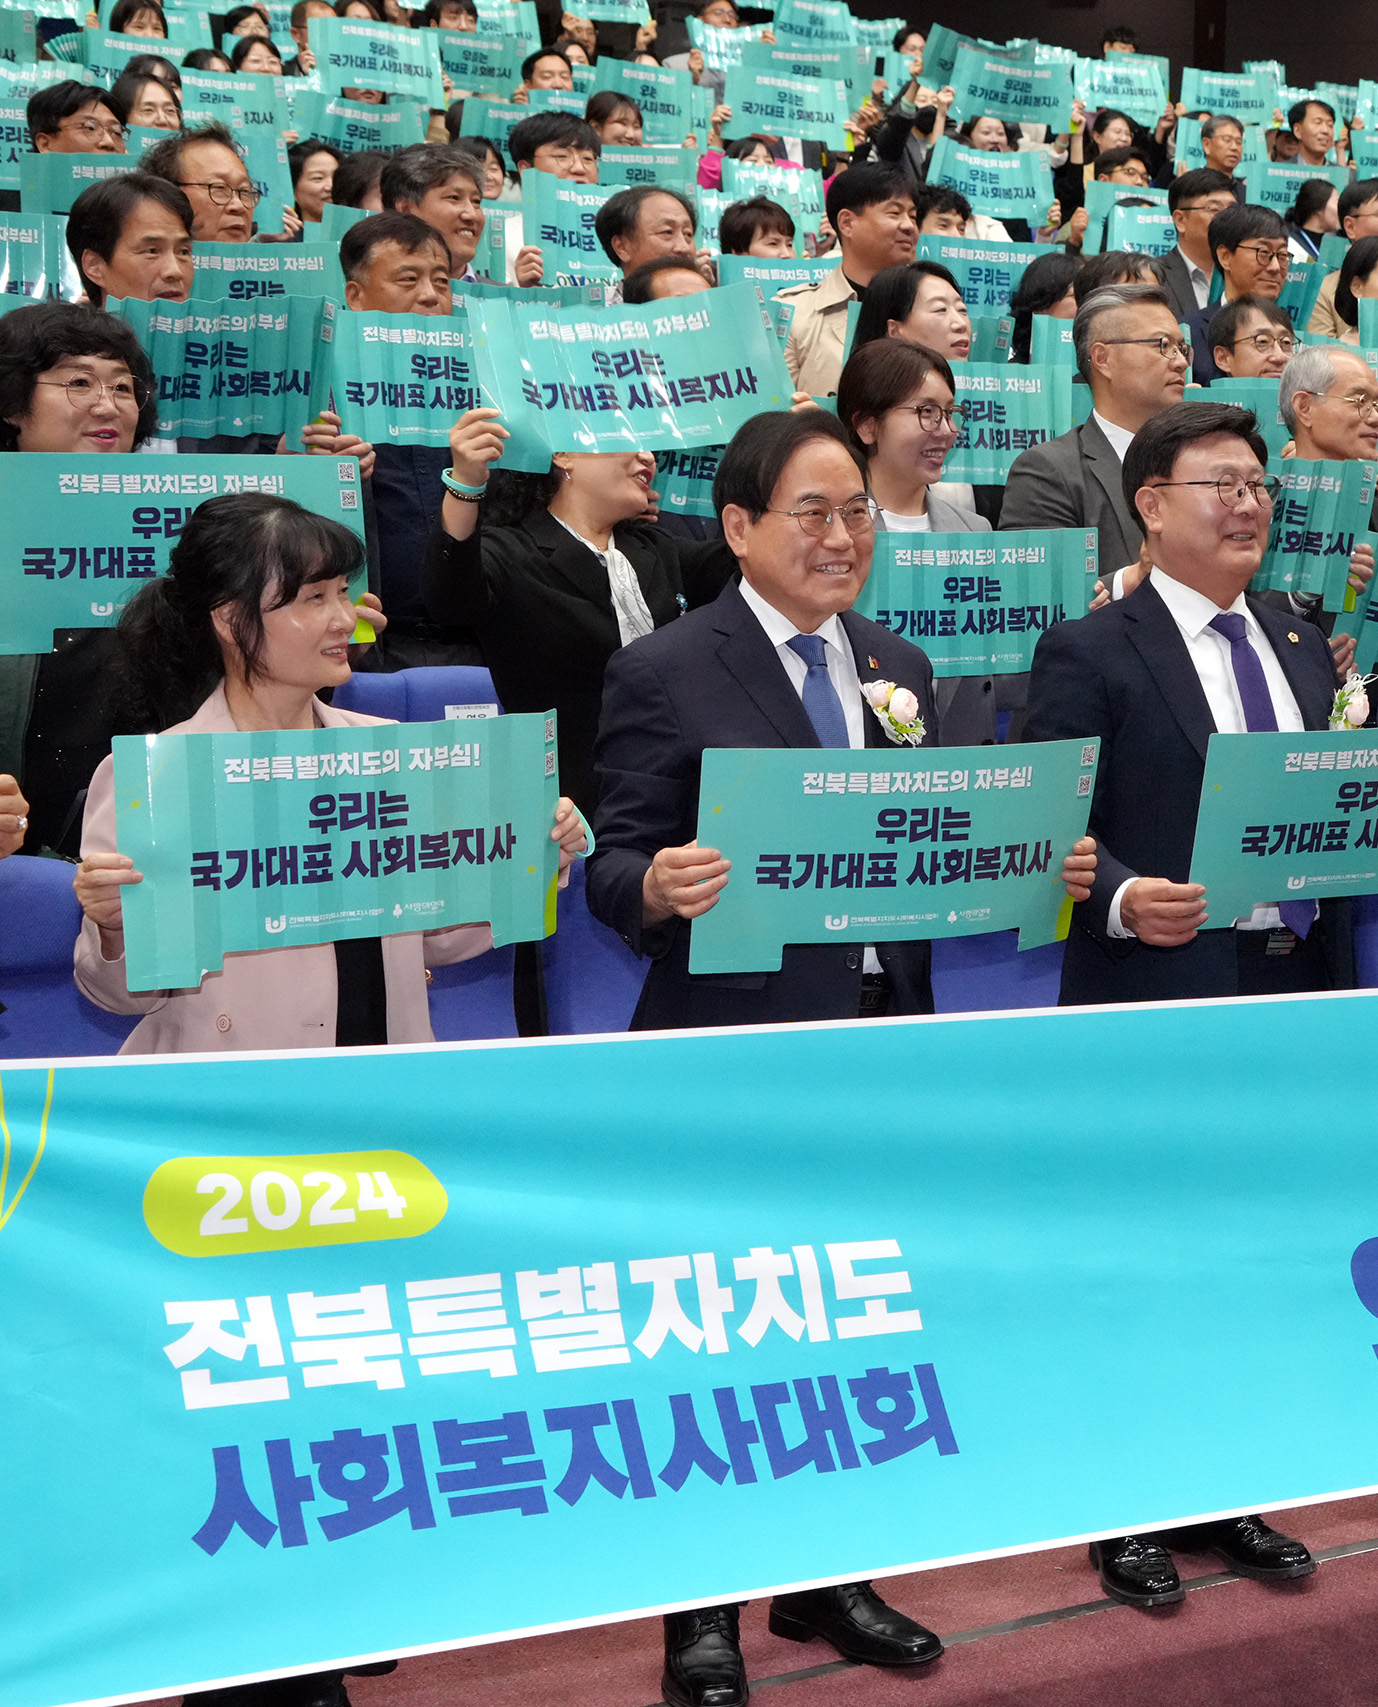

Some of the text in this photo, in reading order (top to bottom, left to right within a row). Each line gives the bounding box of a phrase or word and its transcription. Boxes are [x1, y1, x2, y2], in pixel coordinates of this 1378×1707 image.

[328, 53, 377, 71] 국가대표
[369, 41, 399, 59] 우리는
[967, 85, 1009, 103] 국가대표
[1004, 79, 1033, 92] 우리는
[742, 101, 785, 119] 국가대표
[346, 124, 381, 142] 우리는
[625, 168, 656, 182] 우리는
[969, 169, 1000, 185] 우리는
[284, 257, 324, 271] 자부심!
[968, 267, 1011, 287] 우리는
[362, 326, 463, 347] 전북특별자치도의
[529, 309, 711, 343] 전북특별자치도의 자부심!
[185, 341, 248, 369] 우리는
[411, 353, 470, 383] 우리는
[593, 347, 666, 379] 우리는
[345, 380, 425, 410] 국가대표
[522, 377, 619, 413] 국가대표
[627, 365, 758, 411] 사회복지사
[657, 451, 718, 481] 가대표
[58, 474, 284, 495] 전북특별자치도의 자부심!
[132, 506, 192, 539] 우리
[22, 546, 157, 580] 국가대표
[894, 547, 1046, 566] 전북특별자치도의 자부심!
[943, 576, 1002, 604] 우리는
[223, 743, 482, 784] 전북특별자치도의 자부심!
[802, 766, 1033, 795] 전북특별자치도의 자부심!
[308, 789, 409, 835] 우리는
[875, 806, 971, 845] 우리는
[1241, 820, 1350, 857] 국가대표
[190, 823, 517, 892] 국가대표 사회복지사
[755, 840, 1053, 891] 국가대표 사회복지사
[195, 1171, 408, 1236] 2024
[162, 1239, 923, 1410] 전북특별자치도
[191, 1363, 960, 1557] 사회복지사대회
